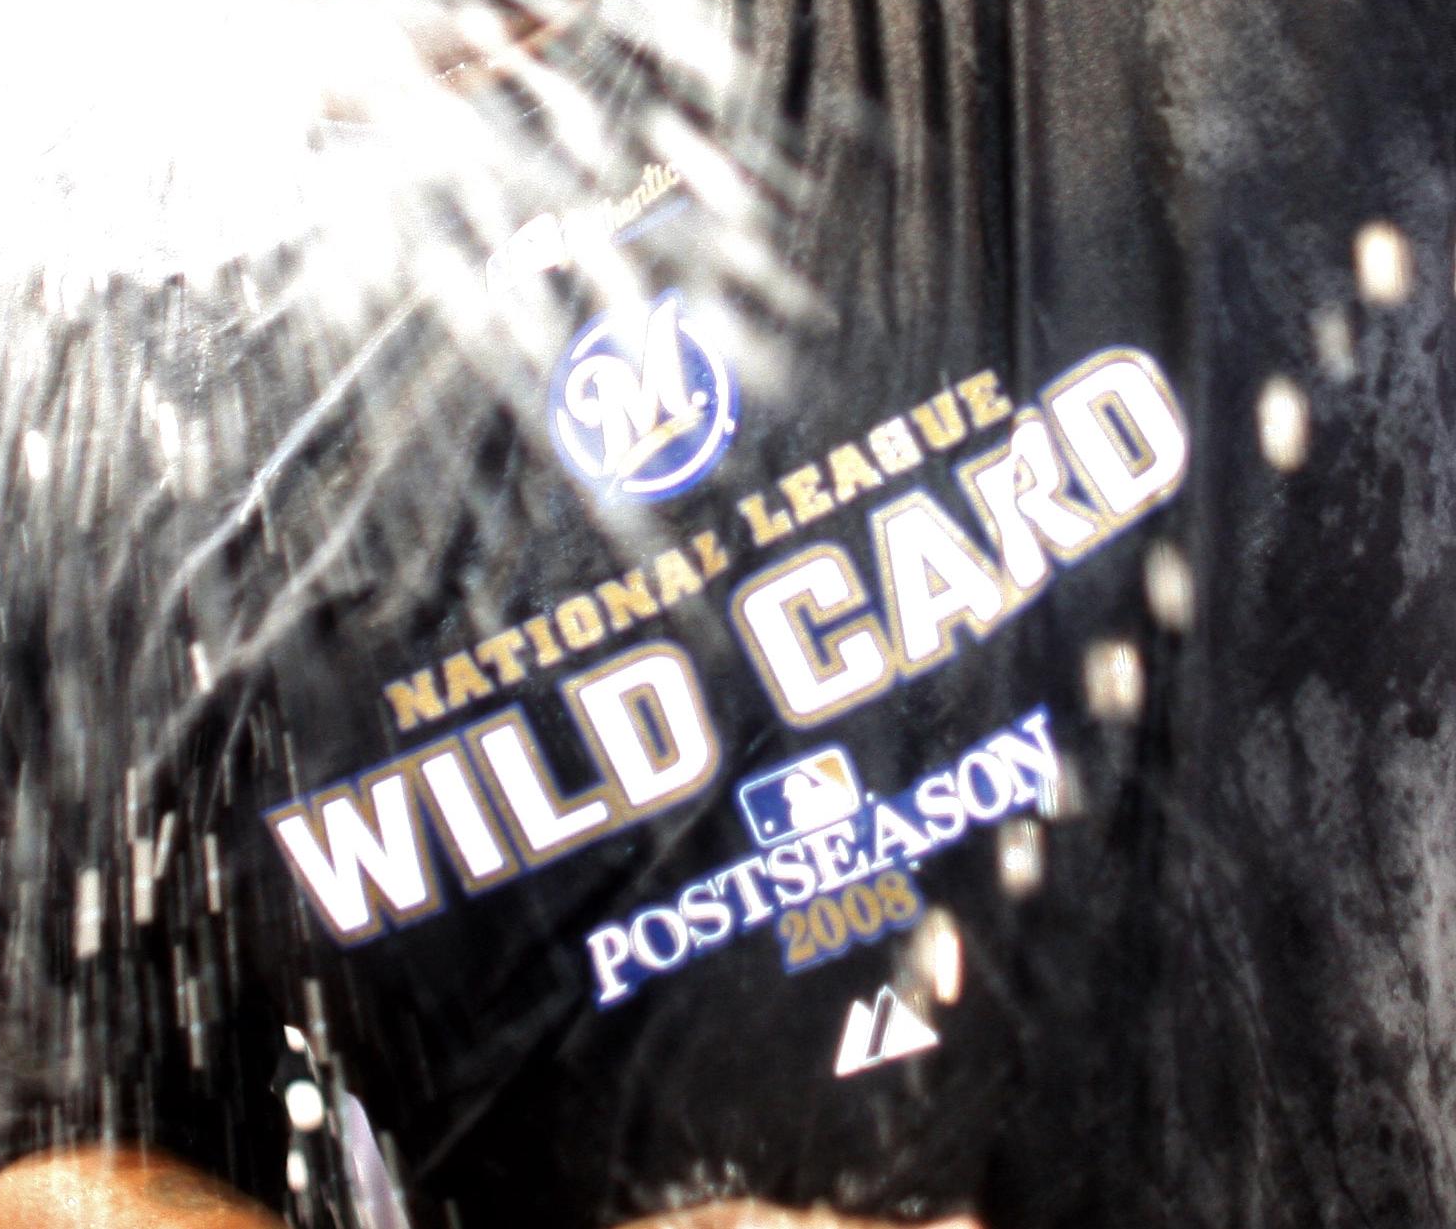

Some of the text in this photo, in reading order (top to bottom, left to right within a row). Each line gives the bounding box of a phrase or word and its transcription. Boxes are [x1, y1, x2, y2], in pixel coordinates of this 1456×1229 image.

[266, 345, 1189, 944] WILD CARD
[384, 370, 1012, 731] NATIONAL LEAGUE
[584, 707, 1062, 1007] POSTSEASON
[776, 870, 922, 972] 2008
